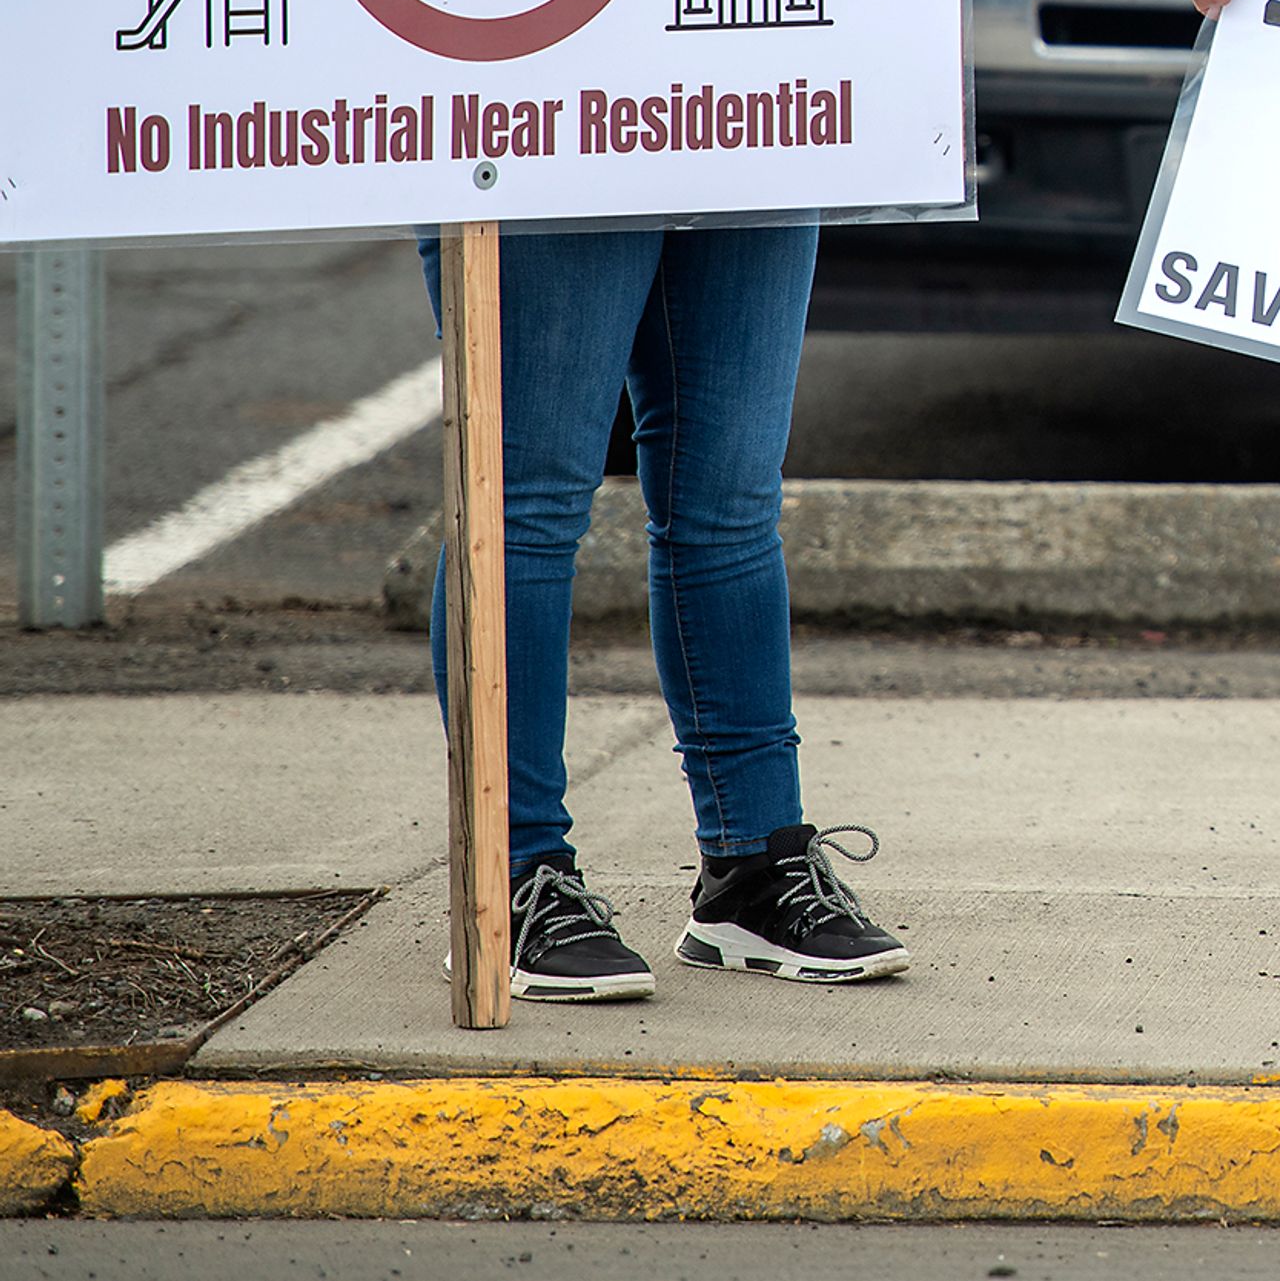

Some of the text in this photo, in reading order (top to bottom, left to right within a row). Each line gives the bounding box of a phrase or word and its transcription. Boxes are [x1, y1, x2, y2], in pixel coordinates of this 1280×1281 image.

[106, 79, 852, 174] No Industrial Near Residential
